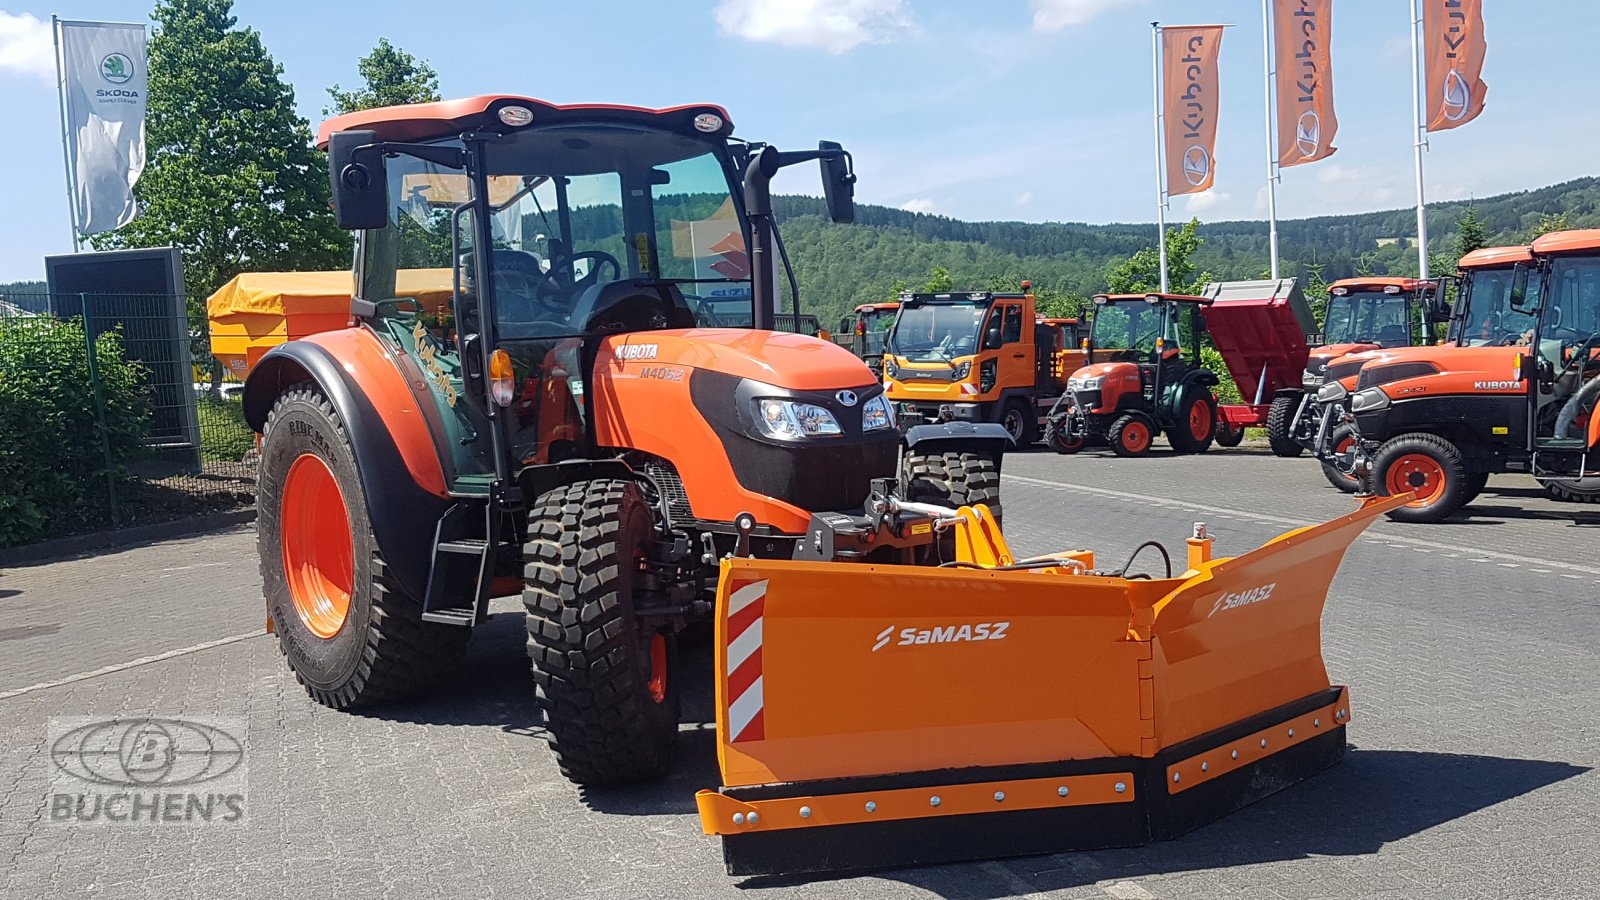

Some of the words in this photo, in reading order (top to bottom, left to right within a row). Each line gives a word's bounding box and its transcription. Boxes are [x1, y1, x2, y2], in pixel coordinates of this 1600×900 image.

[1181, 36, 1204, 138] Kubota
[615, 343, 659, 359] KUBOTA
[1474, 381, 1521, 390] KUBOTA
[1221, 582, 1277, 611] SaMASZ
[897, 621, 1011, 646] SaMASZ
